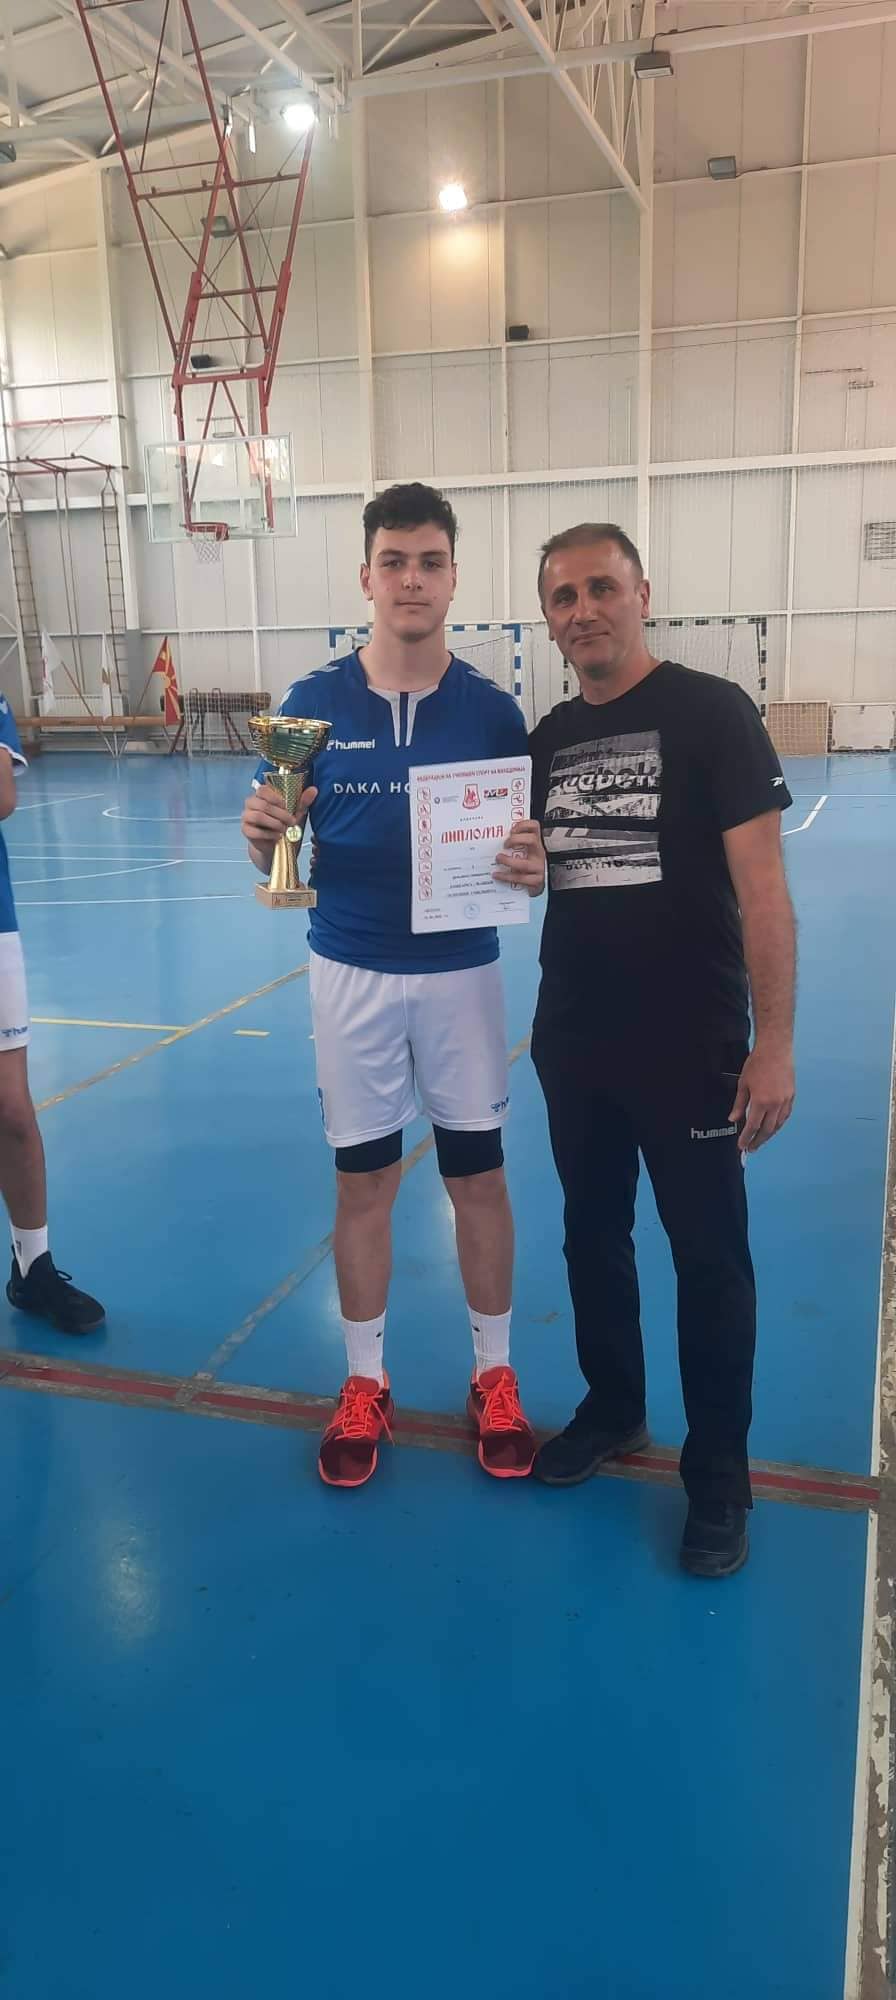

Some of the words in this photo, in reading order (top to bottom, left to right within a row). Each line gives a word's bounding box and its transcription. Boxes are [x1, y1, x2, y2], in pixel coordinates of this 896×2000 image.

[335, 738, 376, 751] hummel
[441, 824, 504, 844] ДИПЛОМА
[690, 1121, 738, 1140] hummel
